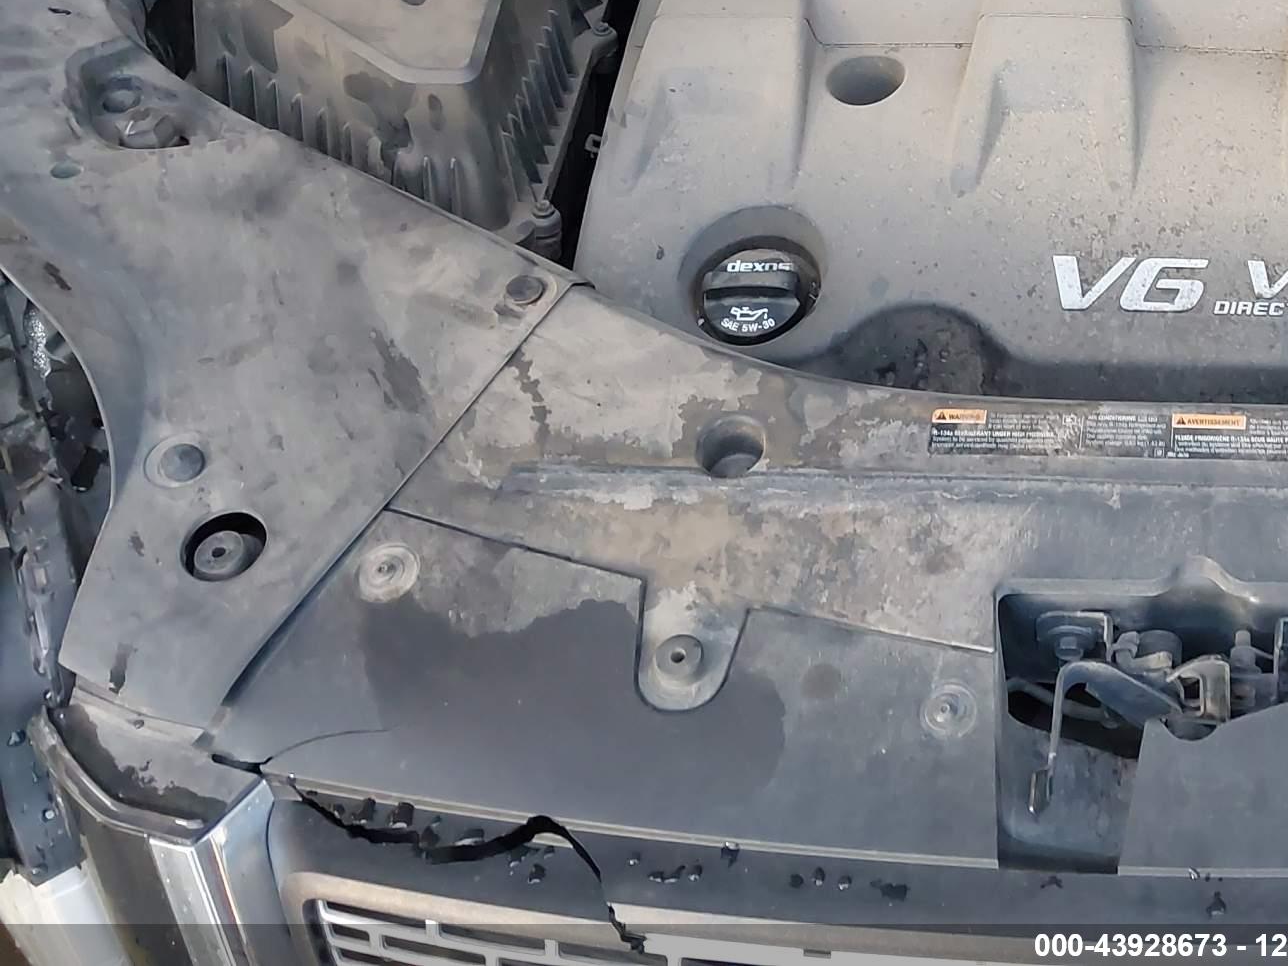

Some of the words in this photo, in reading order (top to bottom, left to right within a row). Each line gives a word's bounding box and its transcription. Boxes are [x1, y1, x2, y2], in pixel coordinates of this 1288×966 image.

[1052, 254, 1210, 312] V6
[720, 317, 740, 332] SAE
[741, 317, 777, 333] 5W-30
